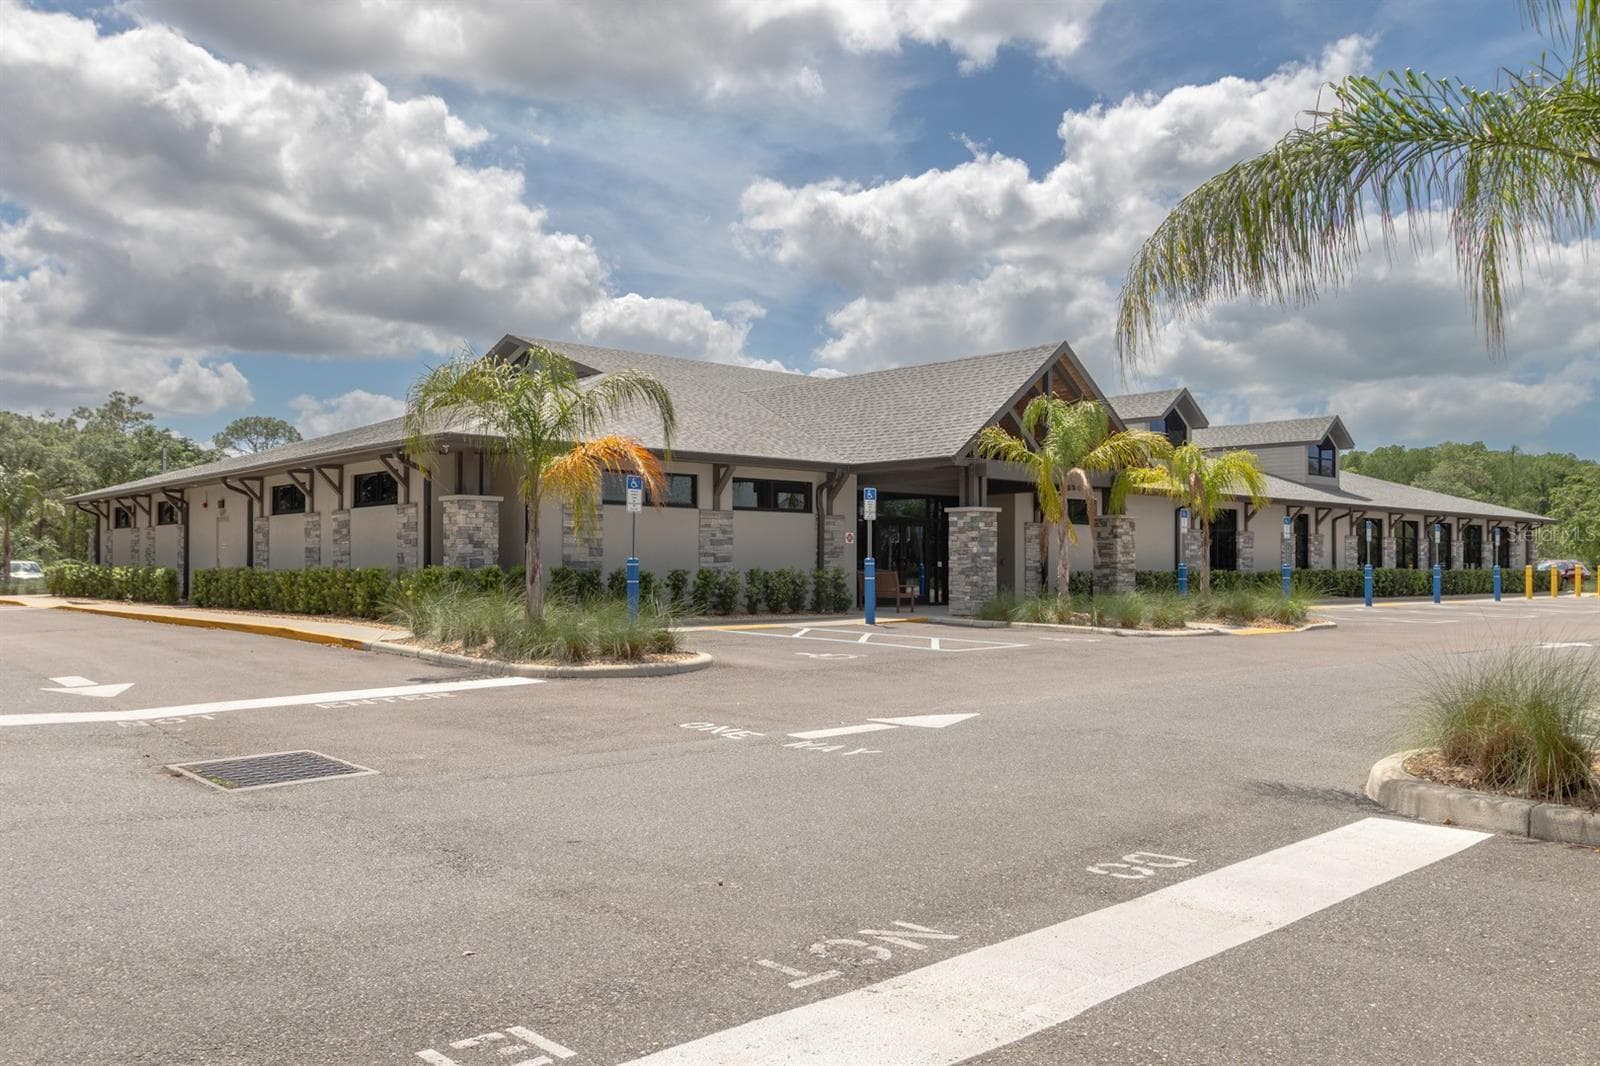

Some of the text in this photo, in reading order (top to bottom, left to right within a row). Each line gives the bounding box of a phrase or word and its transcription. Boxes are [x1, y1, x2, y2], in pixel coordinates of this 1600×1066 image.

[315, 692, 457, 710] ENTER
[679, 721, 766, 740] ONE
[1085, 851, 1199, 879] DO
